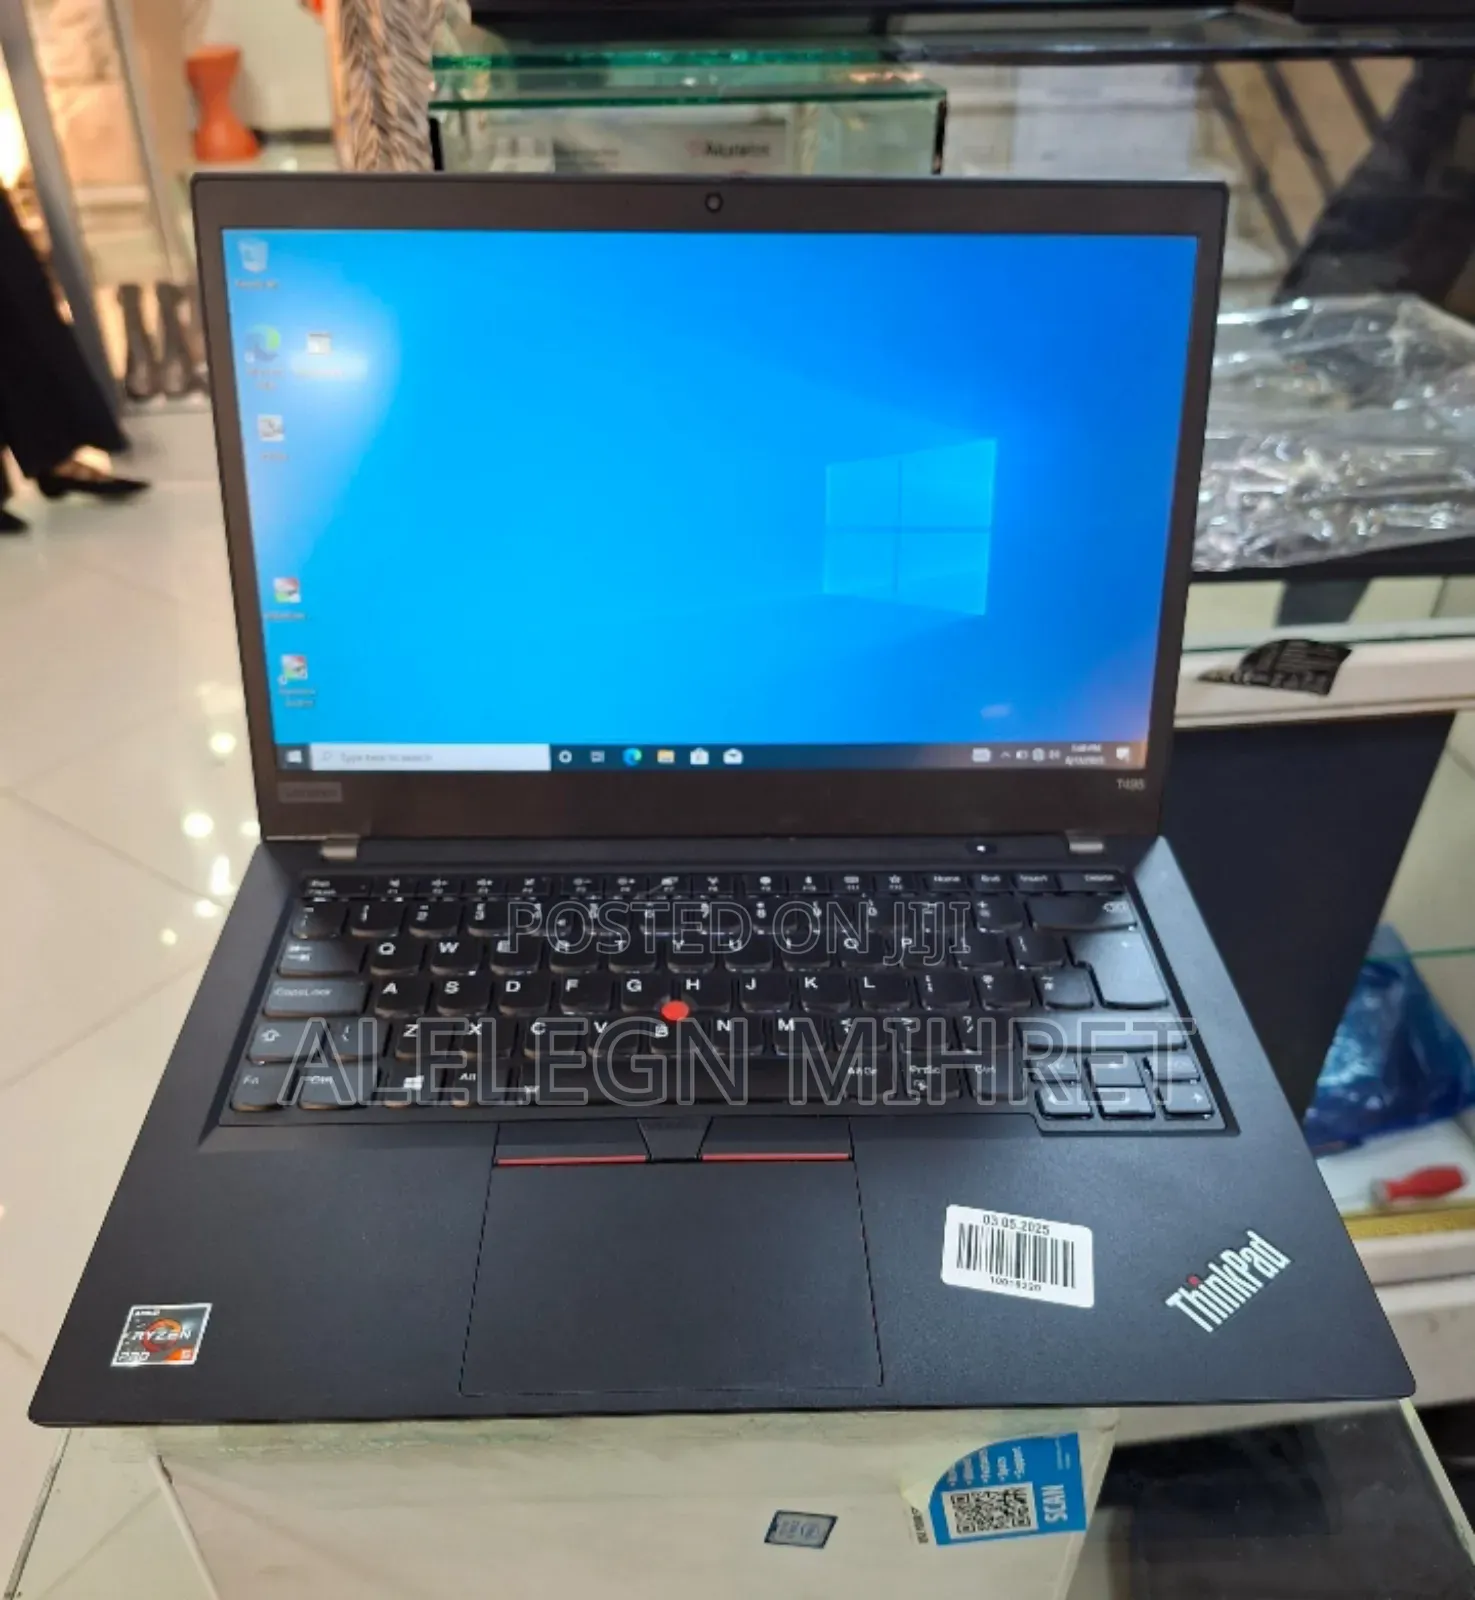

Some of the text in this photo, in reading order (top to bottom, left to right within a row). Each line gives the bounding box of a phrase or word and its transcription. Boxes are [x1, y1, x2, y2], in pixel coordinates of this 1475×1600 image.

[378, 942, 396, 956] Q
[439, 942, 460, 954] W
[614, 939, 626, 952] T
[900, 937, 913, 950] P
[382, 982, 399, 995] A
[444, 981, 460, 994] S
[505, 980, 521, 993] D
[565, 979, 580, 992] F
[626, 979, 643, 992] G
[685, 978, 701, 991] H
[745, 977, 757, 991] J
[804, 976, 819, 990] K
[864, 976, 876, 989] L
[402, 1023, 420, 1037] Z
[467, 1023, 483, 1036] X
[530, 1021, 546, 1035] C
[594, 1020, 608, 1034] V
[716, 1018, 731, 1031] N
[777, 1018, 796, 1031] M
[1164, 1229, 1292, 1333] ThinkPad
[131, 1329, 193, 1341] RYZEN
[1040, 1484, 1069, 1524] SCAN
